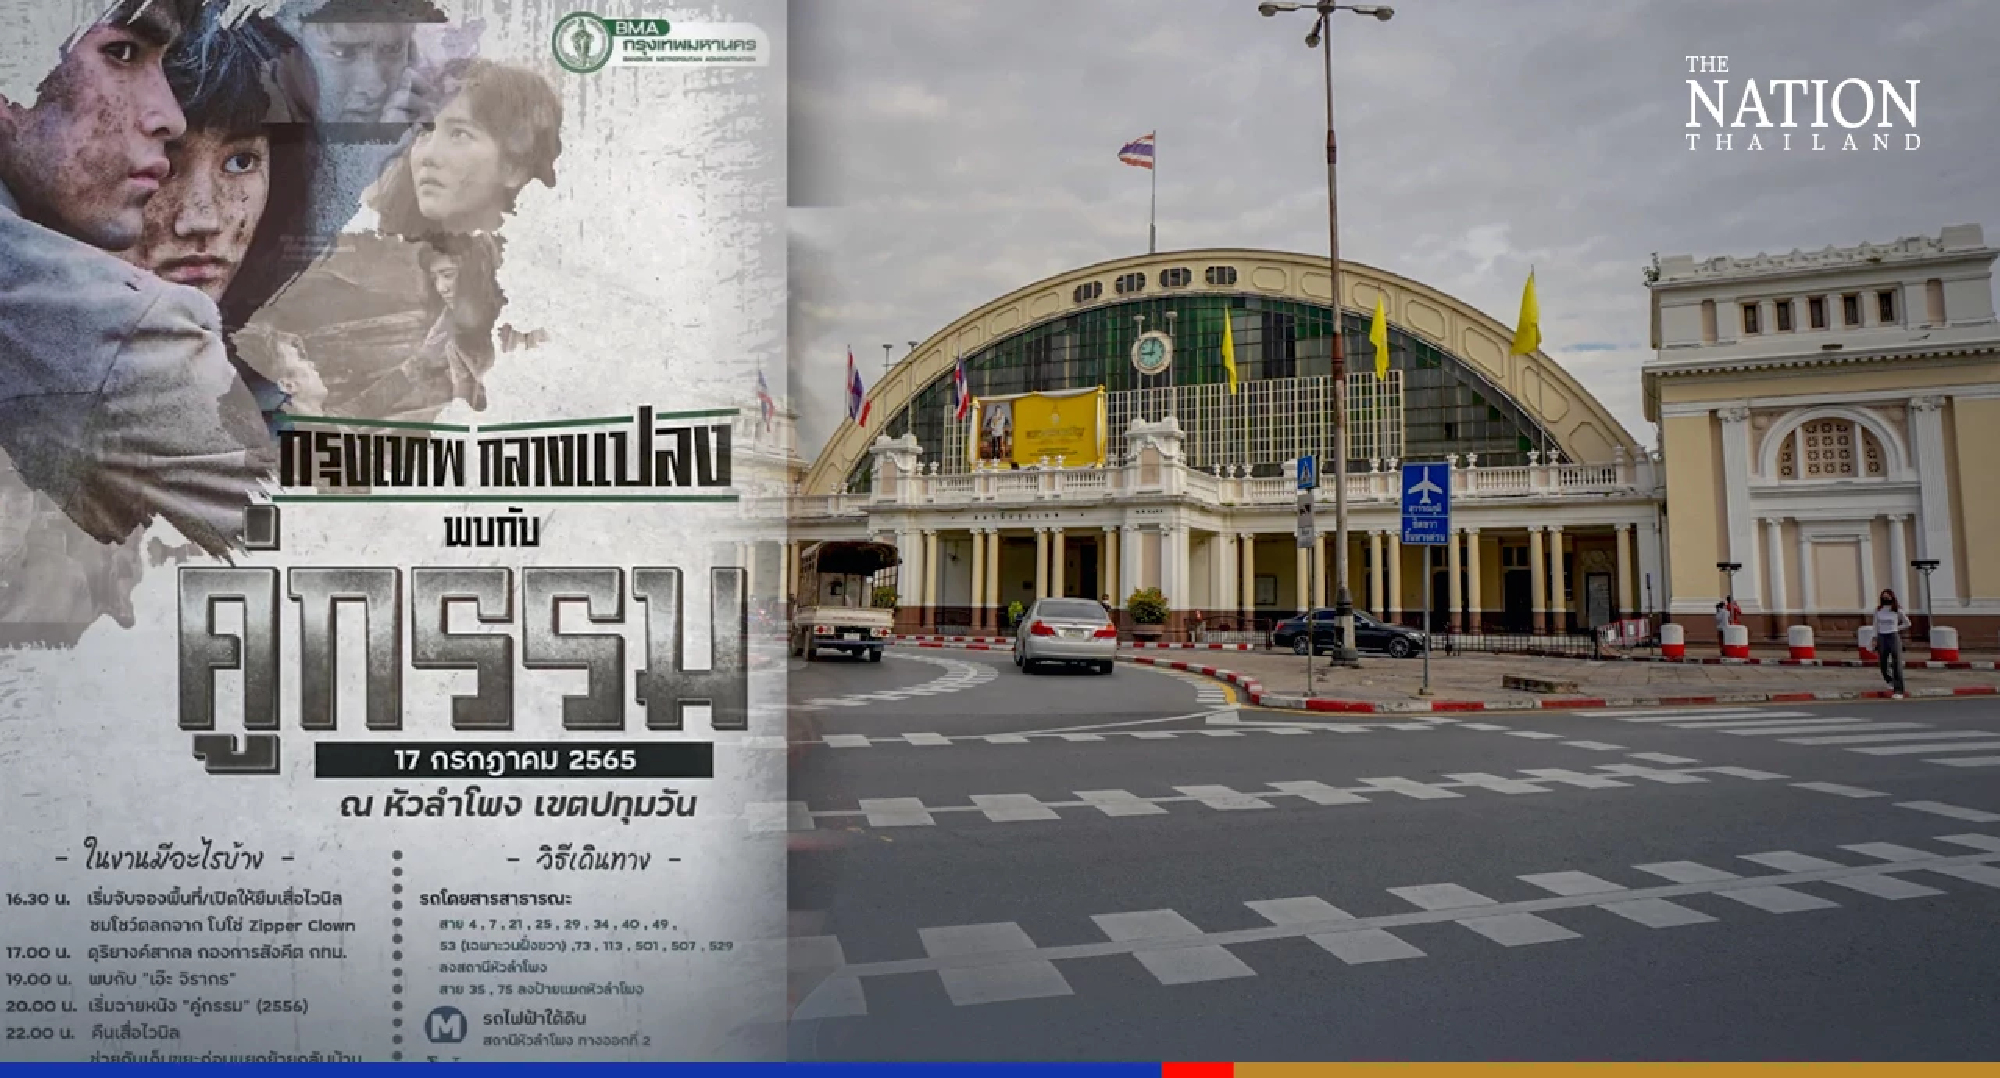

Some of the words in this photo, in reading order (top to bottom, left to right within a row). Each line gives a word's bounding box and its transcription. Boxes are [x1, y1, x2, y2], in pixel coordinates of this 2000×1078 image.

[616, 21, 659, 35] BMA
[623, 39, 756, 55] กรุงเทพมหานคร
[279, 428, 467, 488] กรุงเทพ
[477, 406, 732, 488] กลางแปลง
[444, 508, 540, 548] พบกับ
[177, 505, 748, 774] คู่กรรม
[394, 749, 420, 771] 17
[432, 750, 558, 775] กรกฎาคม
[569, 749, 636, 771] 2565
[340, 795, 373, 818] ณ
[384, 787, 522, 819] หัวลำโพง
[534, 788, 697, 825] เขตปทุมวัน
[84, 835, 264, 870] ในงานมีอะไรบ้าง
[536, 844, 652, 871] วิธีเดินทาง
[6, 893, 50, 906] 16.30
[55, 894, 70, 906] น.
[419, 887, 572, 906] รถโดยสารสาธารณะ
[90, 915, 202, 932] ชมโชว์ตลกจาก
[249, 919, 303, 934] Zipper
[308, 919, 355, 932] Clown
[439, 919, 464, 930] สาย
[468, 919, 477, 930] 4
[489, 919, 497, 930] 7
[508, 919, 522, 930] 21
[535, 919, 552, 930] 25
[564, 919, 580, 930] 29
[594, 919, 609, 930] 34
[622, 919, 639, 930] 40
[652, 919, 669, 930] 49
[6, 947, 50, 959] 17.00
[56, 947, 71, 959] น.
[88, 944, 192, 962] ดุริยางค์สากล
[198, 944, 303, 959] กองการสังคีต
[309, 946, 347, 959] กทม.
[440, 941, 456, 951] 53
[461, 934, 567, 953] (เฉพาะวนฝั่งขวา)
[603, 941, 623, 951] 113
[635, 941, 659, 951] 501
[671, 941, 696, 951] 507
[708, 941, 734, 951] 529
[439, 959, 548, 973] ลงสถานีหัวลำโพง
[6, 973, 51, 986] 19.00
[57, 973, 72, 986] น.
[89, 970, 137, 986] พบกับ
[179, 971, 236, 986] จิรากร"
[439, 984, 464, 995] สาย
[469, 984, 485, 995] 35
[497, 984, 513, 995] 75
[518, 980, 644, 996] ลงป้ายแยกหัวลำโพง
[6, 1000, 56, 1012] 20.00
[61, 1000, 77, 1012] น.
[89, 992, 177, 1012] เริ่มฉายหนัง
[183, 996, 250, 1017] "คู่กรรม"
[256, 998, 309, 1015] (2556)
[483, 1008, 587, 1026] รถไฟฟ้าใต้ดิน
[6, 1027, 54, 1039] 22.00
[59, 1027, 75, 1039] น.
[92, 1020, 180, 1039] คืนเสื่อไวนิล
[483, 1033, 574, 1046] สถานีหัวลำโพง
[578, 1030, 638, 1046] ทางออกที่
[642, 1035, 651, 1046] 2
